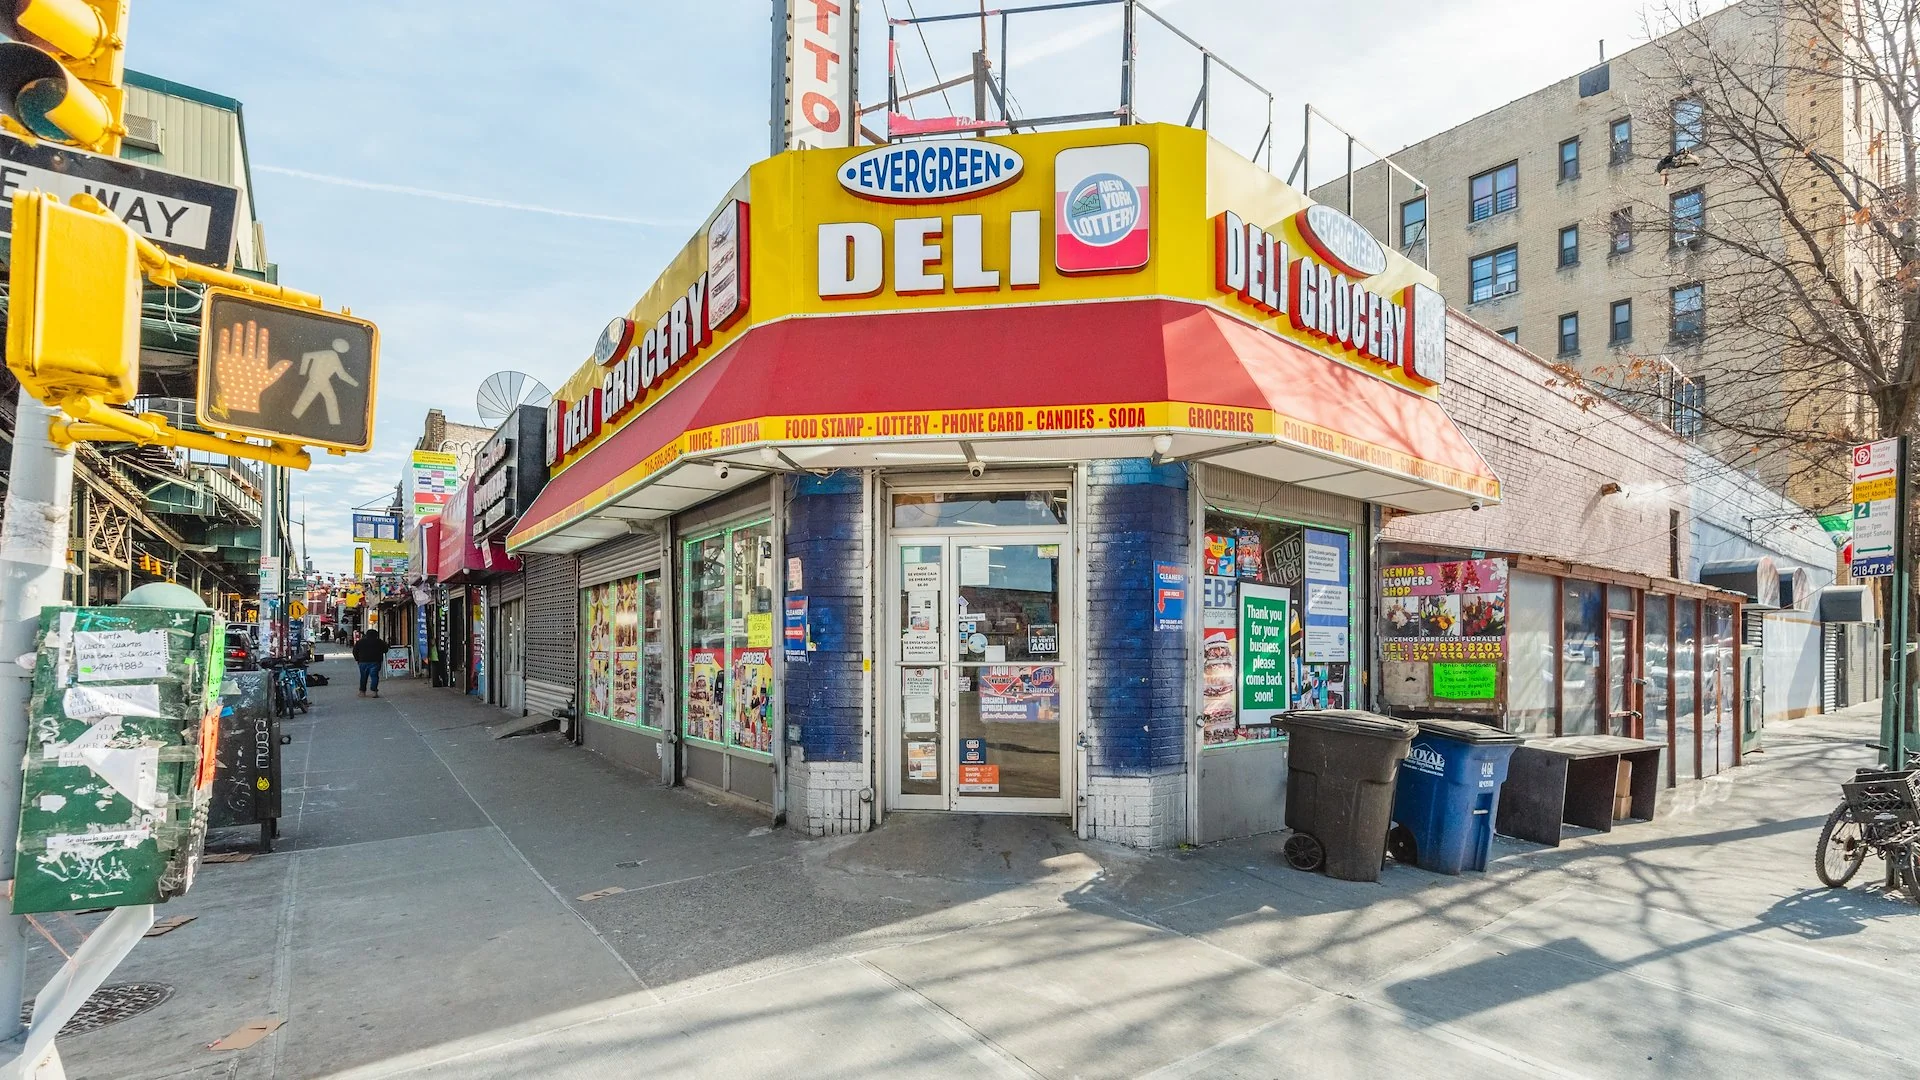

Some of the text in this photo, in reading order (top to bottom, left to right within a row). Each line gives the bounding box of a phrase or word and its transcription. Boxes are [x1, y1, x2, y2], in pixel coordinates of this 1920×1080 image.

[859, 147, 1001, 193] EVERGREEN
[1099, 179, 1124, 193] NEW
[1102, 191, 1133, 209] YORK
[1073, 205, 1136, 237] LOTTERY
[818, 210, 1041, 297] DELI
[1317, 217, 1381, 273] EVERGREEN
[1226, 210, 1289, 314] DELI
[1299, 256, 1407, 367] GROCERY
[602, 270, 708, 424] GROCERY
[563, 388, 595, 455] DELI
[785, 407, 1145, 439] FOOD STAMP LOTTERY PHONE CARD CANDIES SODA
[1188, 407, 1254, 433] GROCERIES
[689, 422, 760, 451] JUICE FRITURA
[1283, 420, 1309, 444] COLD
[1311, 426, 1334, 451] BEER
[1341, 438, 1371, 463] PHONE
[1371, 445, 1393, 469] CARD
[1855, 483, 1872, 492] Meters
[1873, 481, 1883, 489] Are
[1855, 491, 1870, 500] Effect
[1870, 490, 1886, 498] Above
[1857, 502, 1867, 518] 2
[1383, 566, 1425, 577] KENIA'S
[1383, 576, 1433, 587] FLOWERS
[1204, 579, 1237, 608] EBT
[1383, 587, 1411, 597] SHOP
[1247, 604, 1283, 624] Thank you
[1251, 622, 1280, 639] for your
[1031, 643, 1056, 652] AQUI
[1249, 638, 1281, 655] business,
[1383, 643, 1501, 652] TEL: 347.832.8203
[694, 652, 715, 664] GROCERY
[741, 651, 767, 665] GROCERY
[1252, 655, 1276, 672] please
[1383, 652, 1409, 661] TEL:
[992, 666, 1009, 676] AQUI
[1246, 673, 1283, 686] come back
[1254, 689, 1274, 702] soon!
